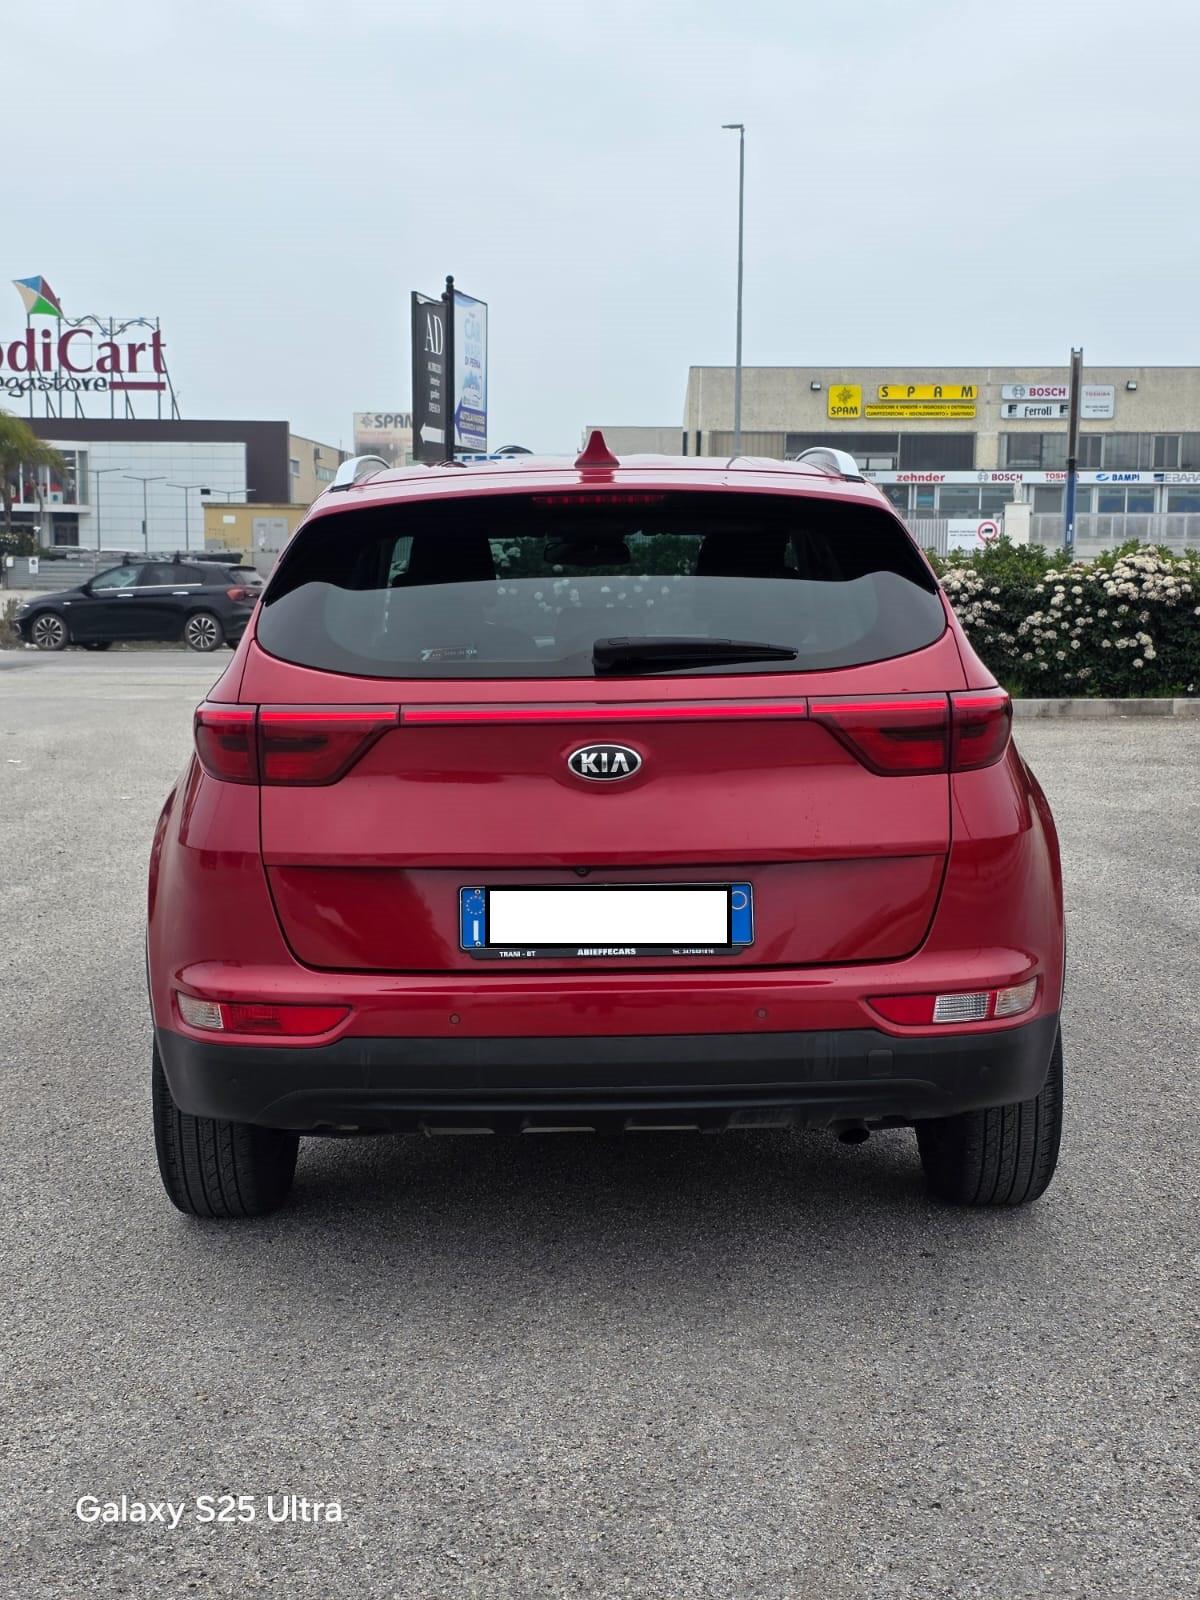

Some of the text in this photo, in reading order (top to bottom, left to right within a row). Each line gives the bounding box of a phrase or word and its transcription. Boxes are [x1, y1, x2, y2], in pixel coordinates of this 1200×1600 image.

[424, 312, 443, 355] AD
[0, 328, 167, 374] diCart
[1029, 387, 1067, 397] BOSCH
[831, 406, 858, 415] SPAM
[896, 473, 945, 482] zehnder
[991, 473, 1023, 481] BOSCH
[580, 752, 630, 773] KIA
